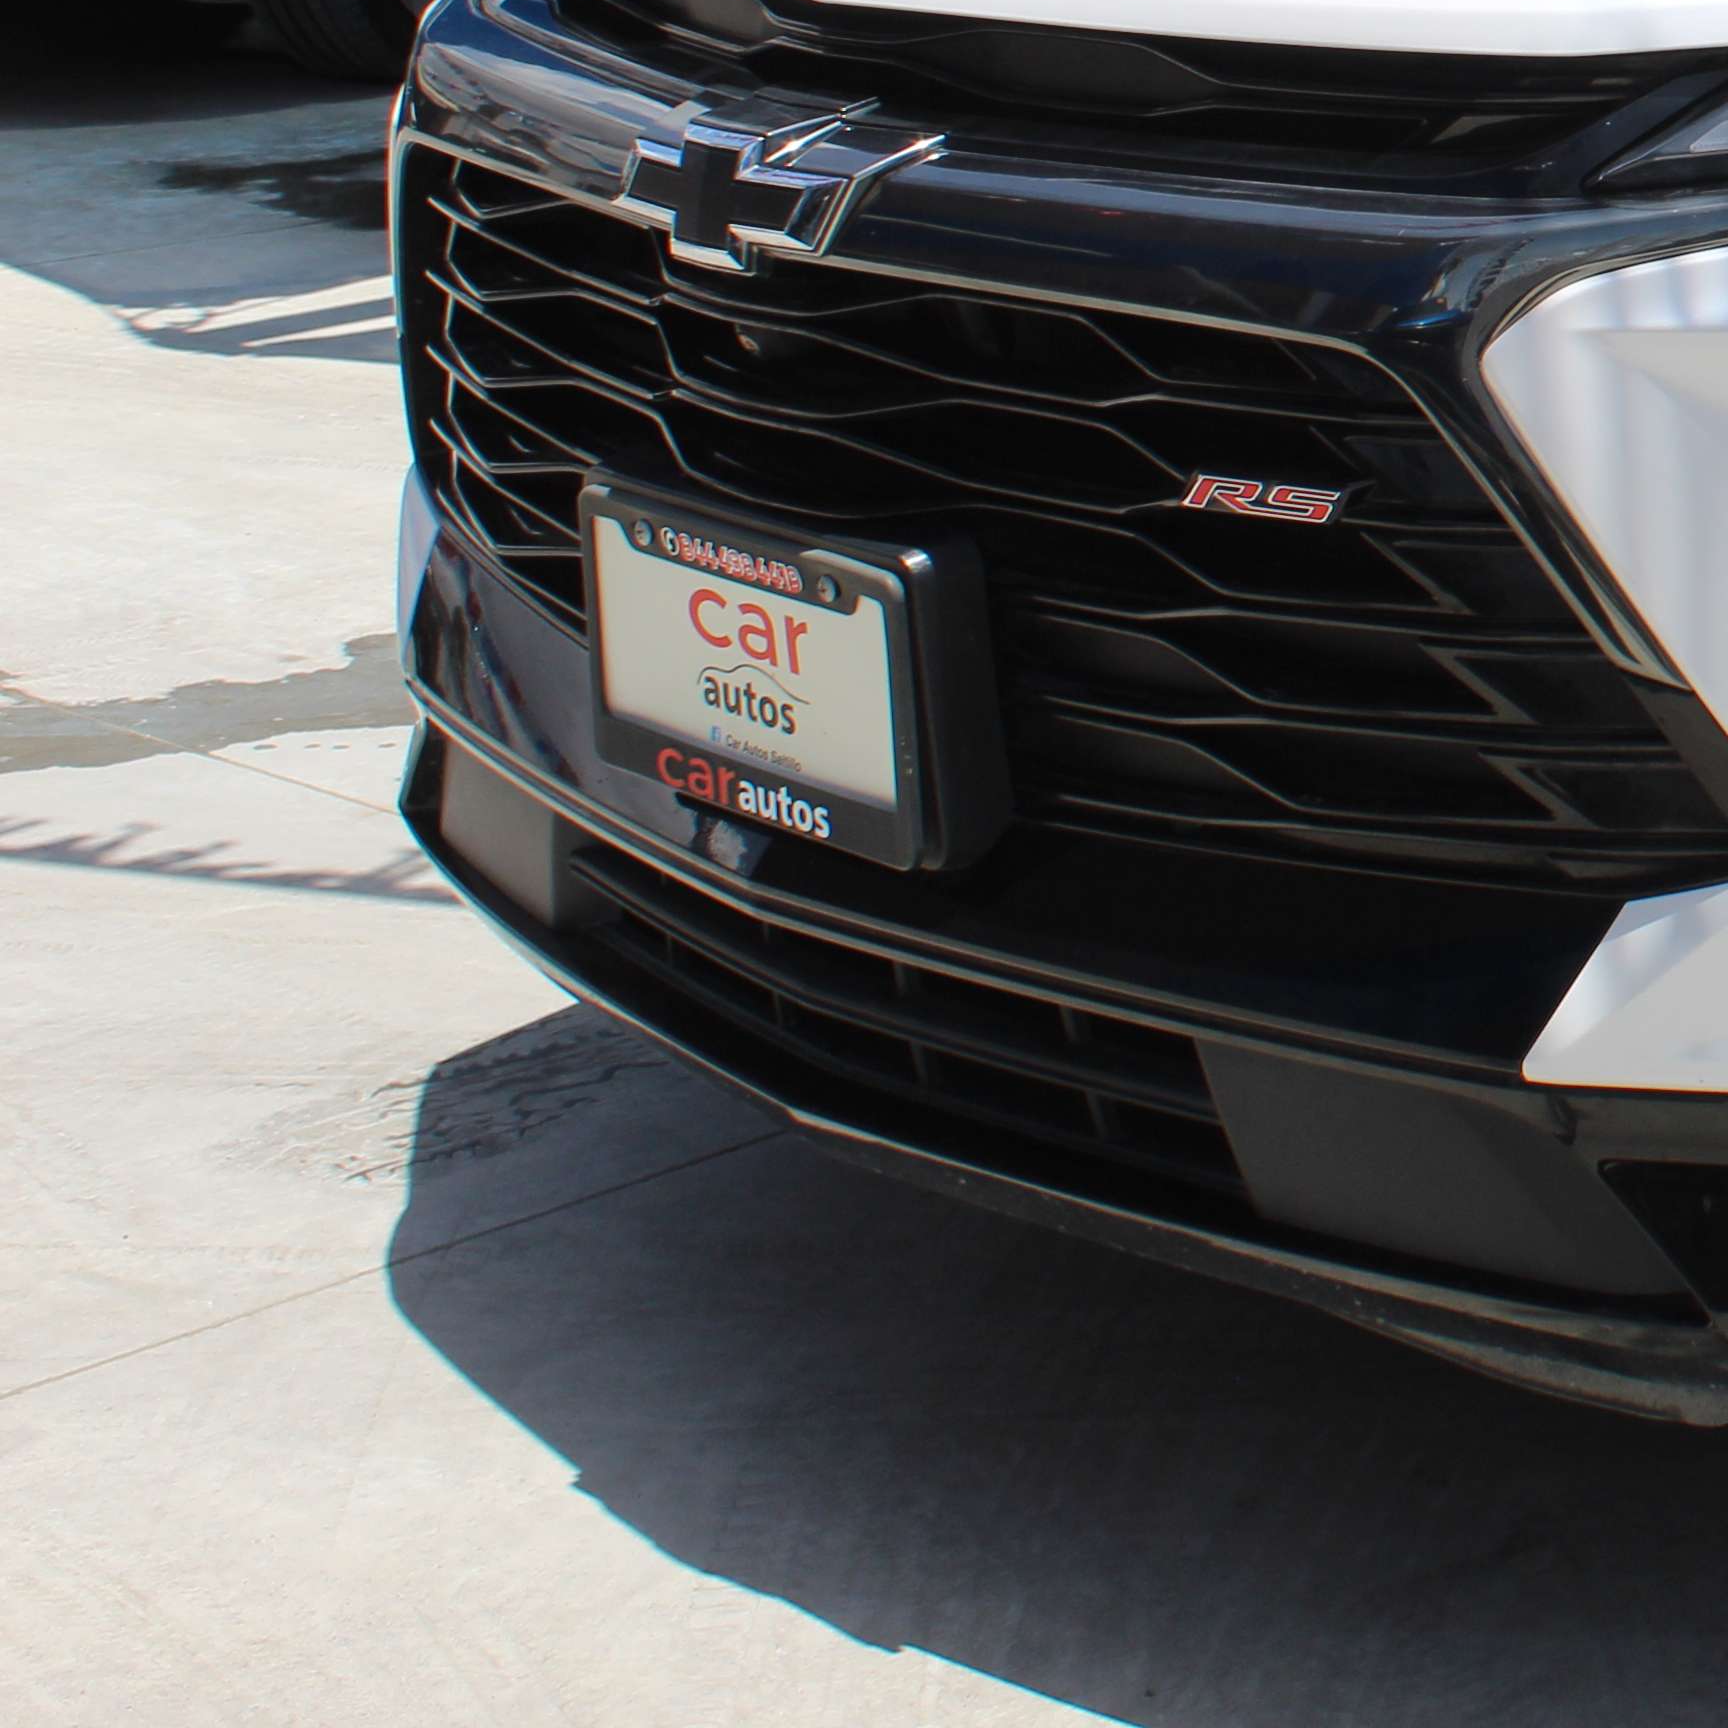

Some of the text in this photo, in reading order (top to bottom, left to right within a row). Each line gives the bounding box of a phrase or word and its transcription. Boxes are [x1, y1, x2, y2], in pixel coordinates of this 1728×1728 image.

[1181, 475, 1341, 523] RS
[688, 588, 809, 676] car
[703, 674, 797, 735] autos
